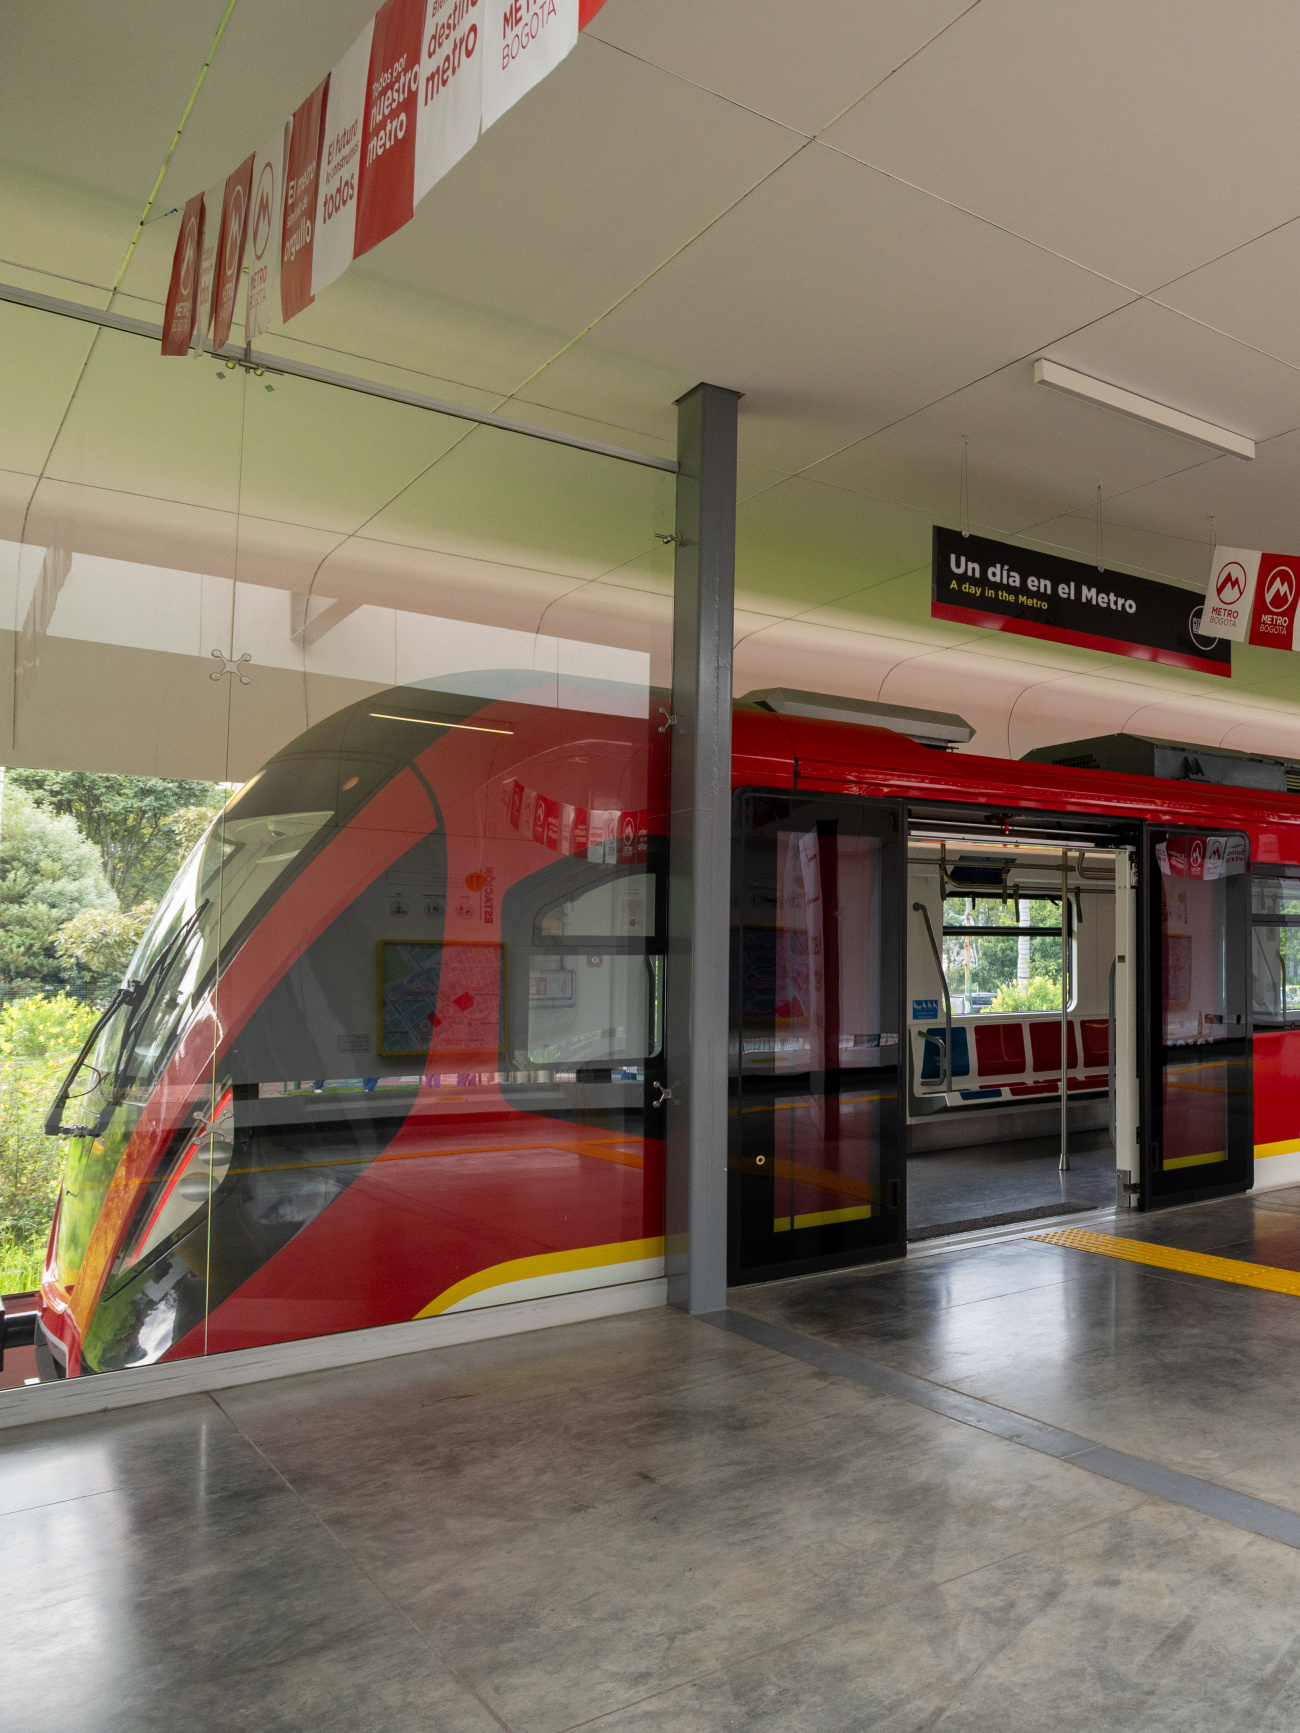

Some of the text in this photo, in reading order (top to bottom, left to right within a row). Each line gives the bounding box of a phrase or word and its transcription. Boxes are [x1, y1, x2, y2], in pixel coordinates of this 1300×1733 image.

[372, 53, 407, 100] Todos por
[424, 23, 478, 107] metro
[370, 64, 420, 132] nuestro
[327, 119, 358, 166] El futuro
[366, 112, 406, 167] metro
[288, 177, 297, 205] El
[323, 173, 354, 224] todos
[285, 216, 311, 262] orgullo
[950, 553, 1137, 614] Un día en el Metro
[950, 580, 1048, 609] A day in the Metro
[1209, 616, 1237, 628] BOGOTÁ
[1211, 606, 1239, 619] METRO
[1259, 623, 1287, 635] BOGOTÁ
[1261, 613, 1289, 627] METRO
